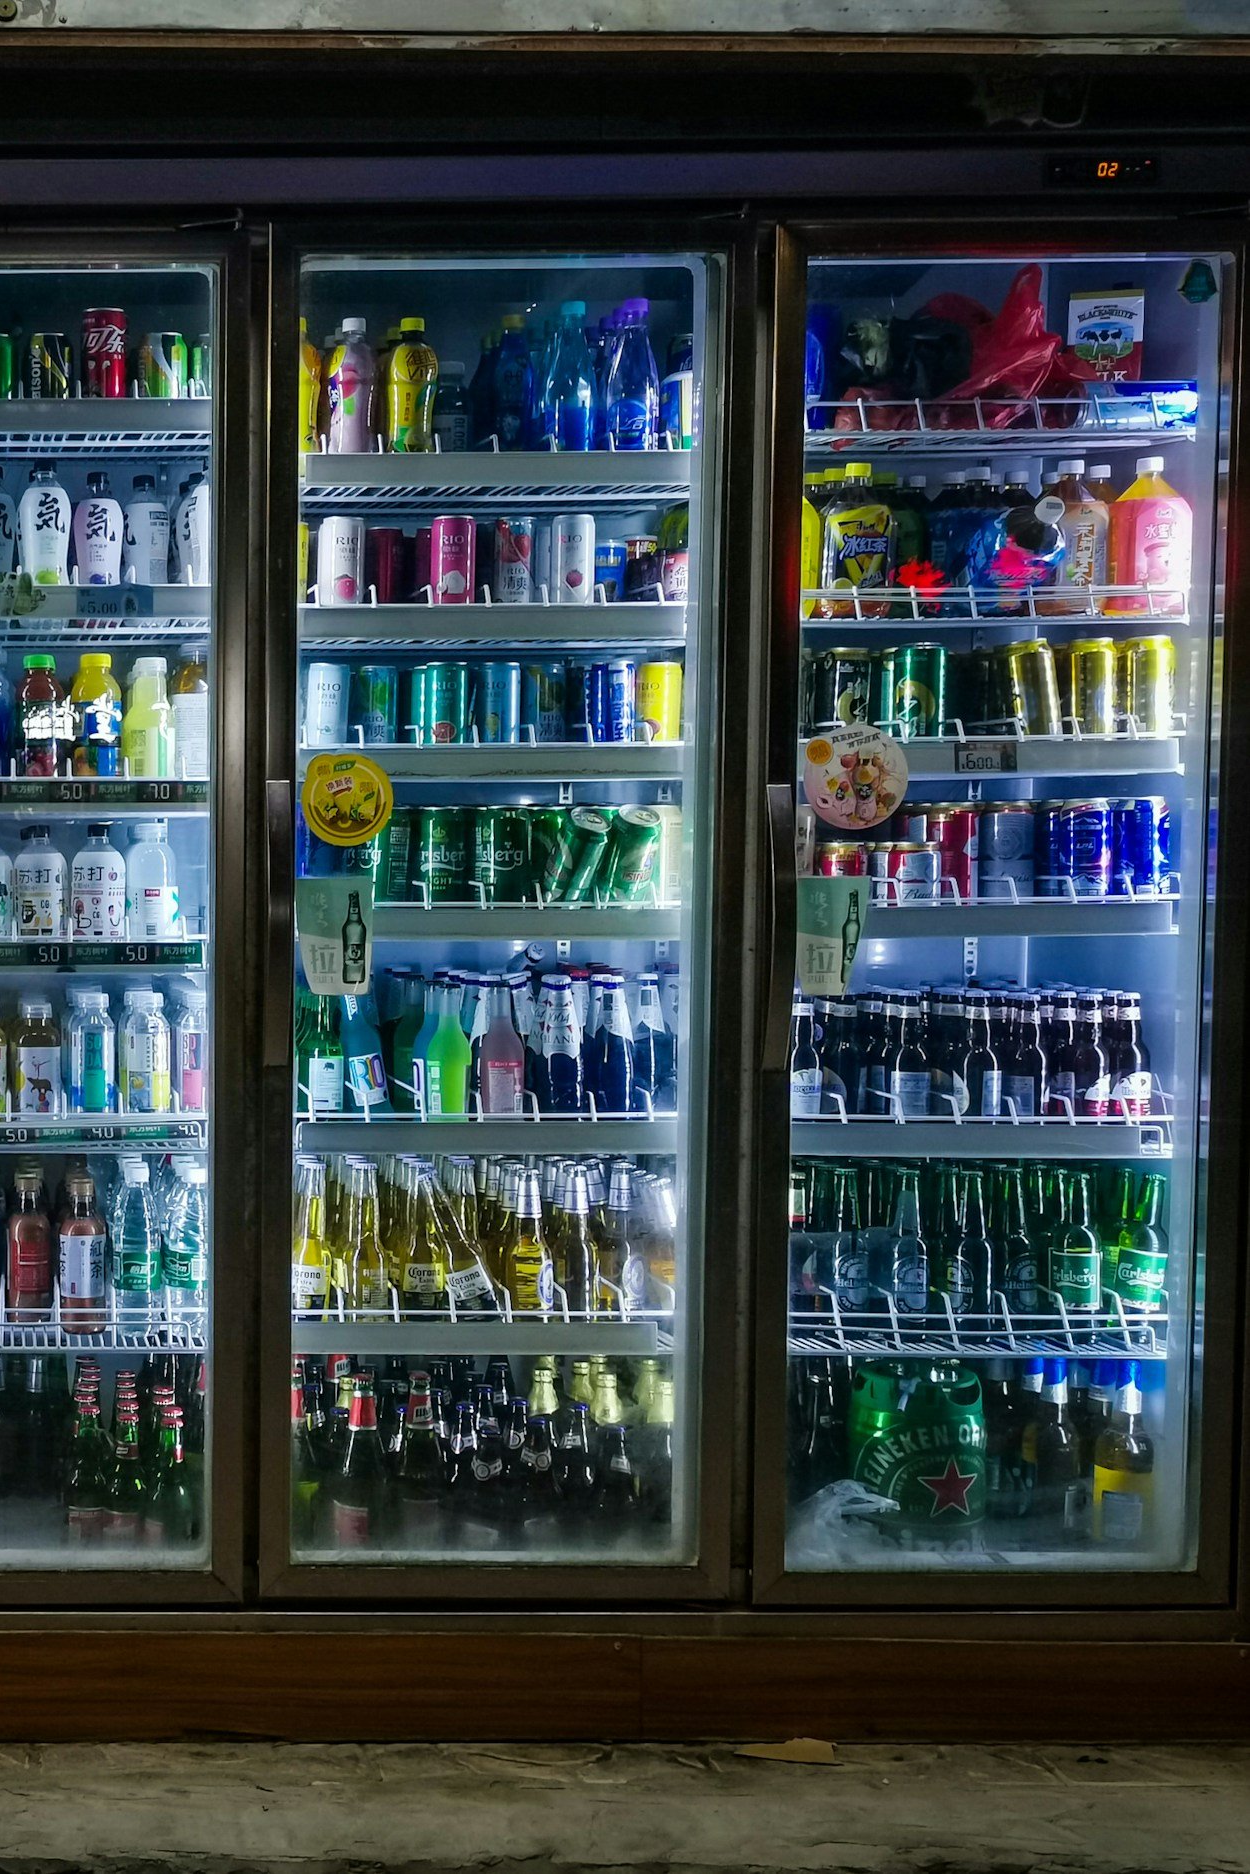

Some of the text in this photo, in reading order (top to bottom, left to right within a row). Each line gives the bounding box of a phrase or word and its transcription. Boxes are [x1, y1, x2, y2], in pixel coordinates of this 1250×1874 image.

[1097, 162, 1118, 177] 02
[336, 537, 359, 545] RIO
[441, 535, 465, 544] RIO
[559, 534, 582, 543] RIO
[839, 534, 888, 560] 冰红茶
[317, 683, 341, 691] RIO
[18, 867, 52, 884] 苏打
[74, 866, 105, 882] 苏打
[309, 944, 337, 974] 拉
[806, 943, 837, 974] 拉
[351, 1054, 386, 1091] RIO
[408, 1266, 442, 1278] Corona
[450, 1269, 481, 1287] Corona
